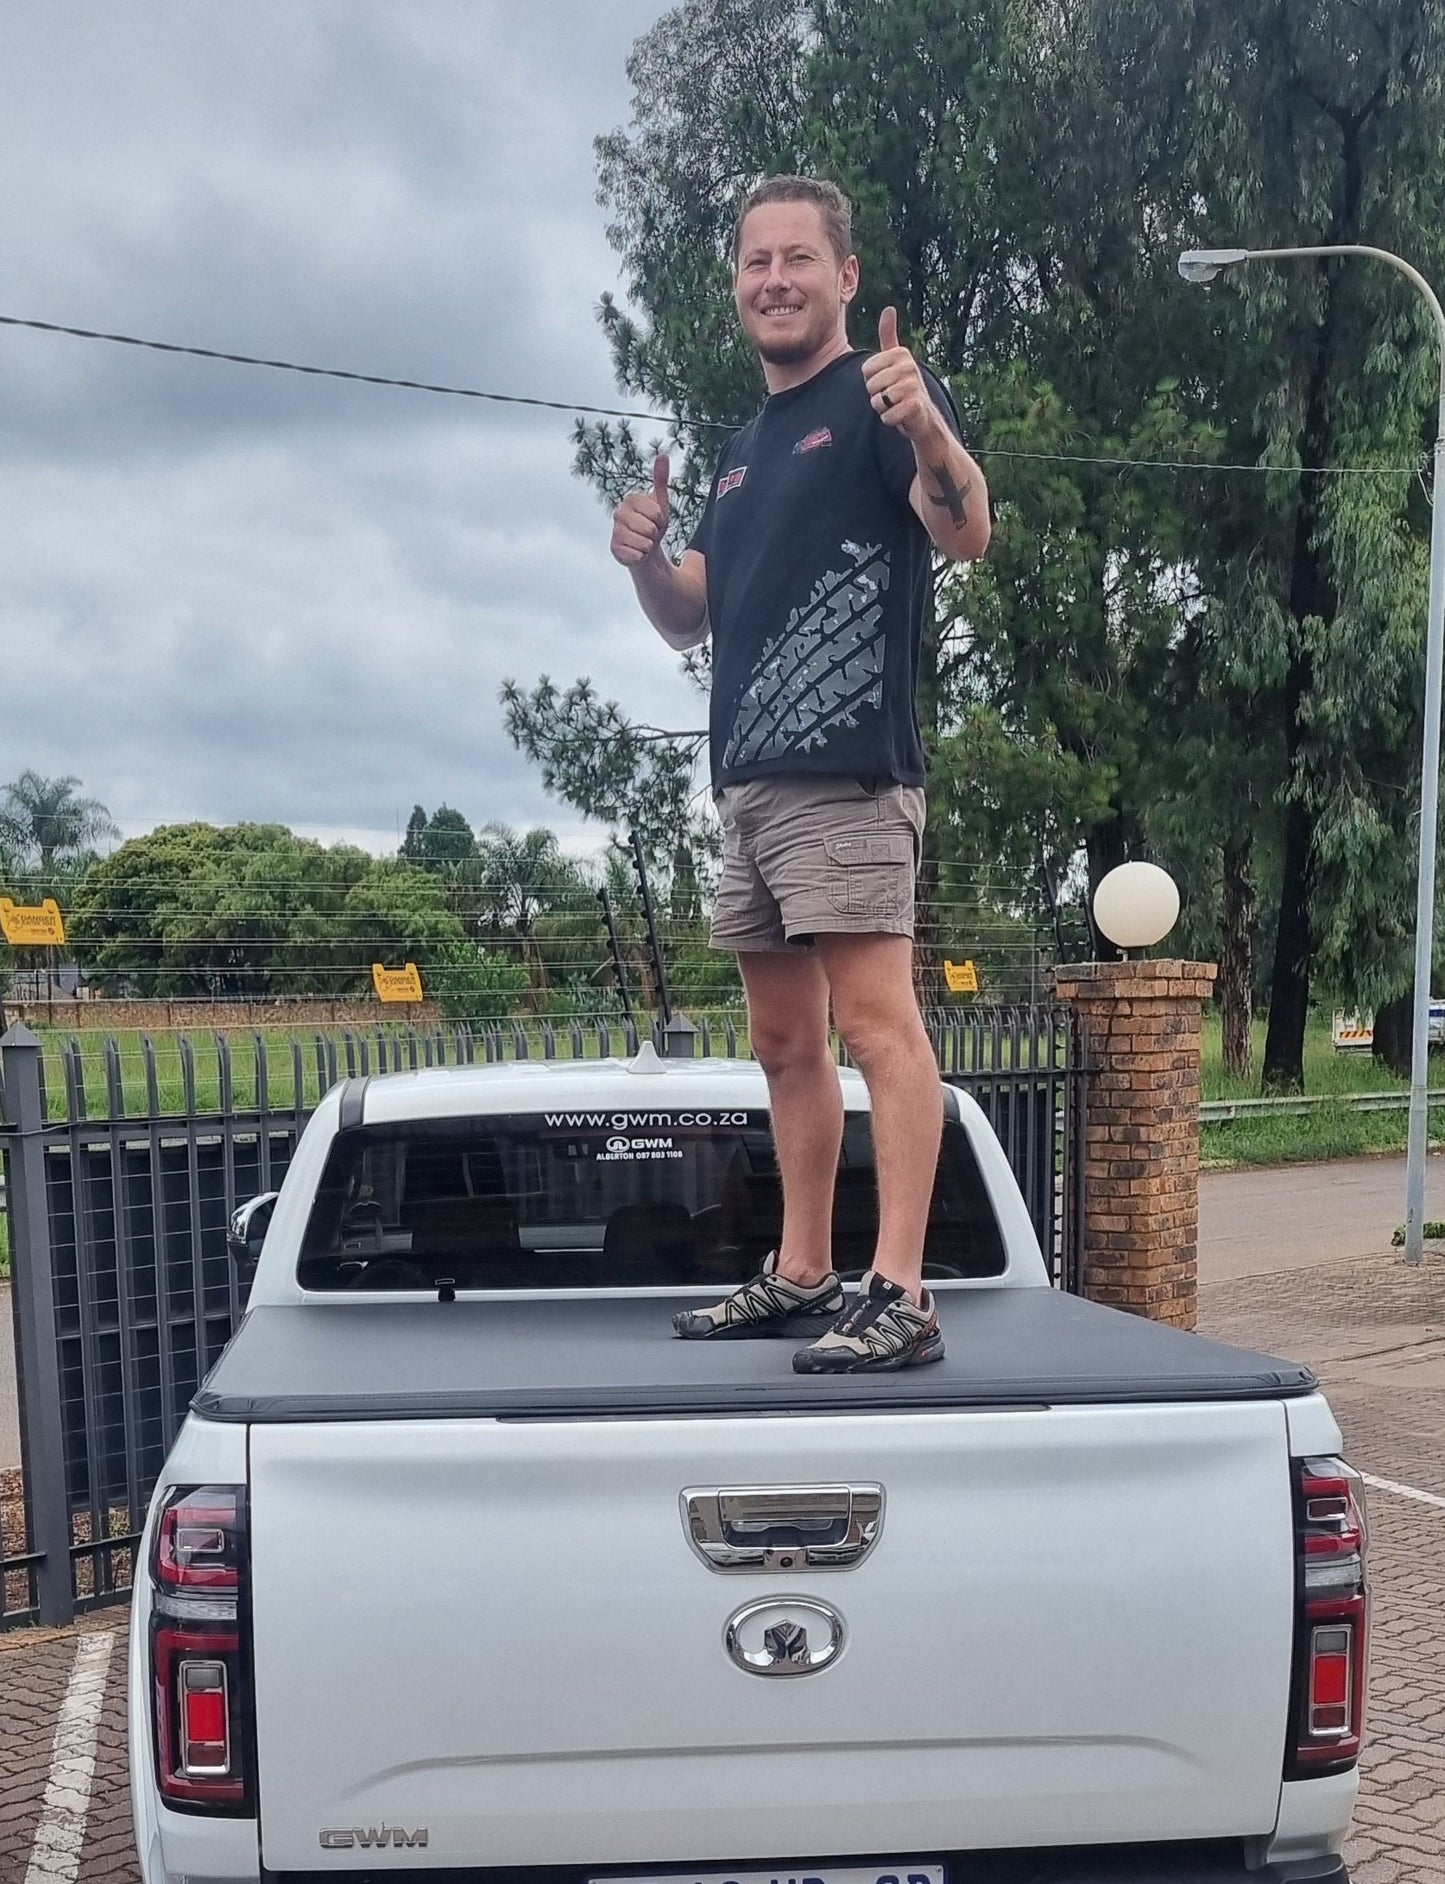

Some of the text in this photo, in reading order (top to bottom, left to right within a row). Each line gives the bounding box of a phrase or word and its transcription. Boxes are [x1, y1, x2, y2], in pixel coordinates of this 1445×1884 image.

[545, 1112, 748, 1130] www.gwm.co.za
[631, 1138, 673, 1149] GWM
[596, 1152, 634, 1160] ALBERTON
[319, 1827, 428, 1848] GWM
